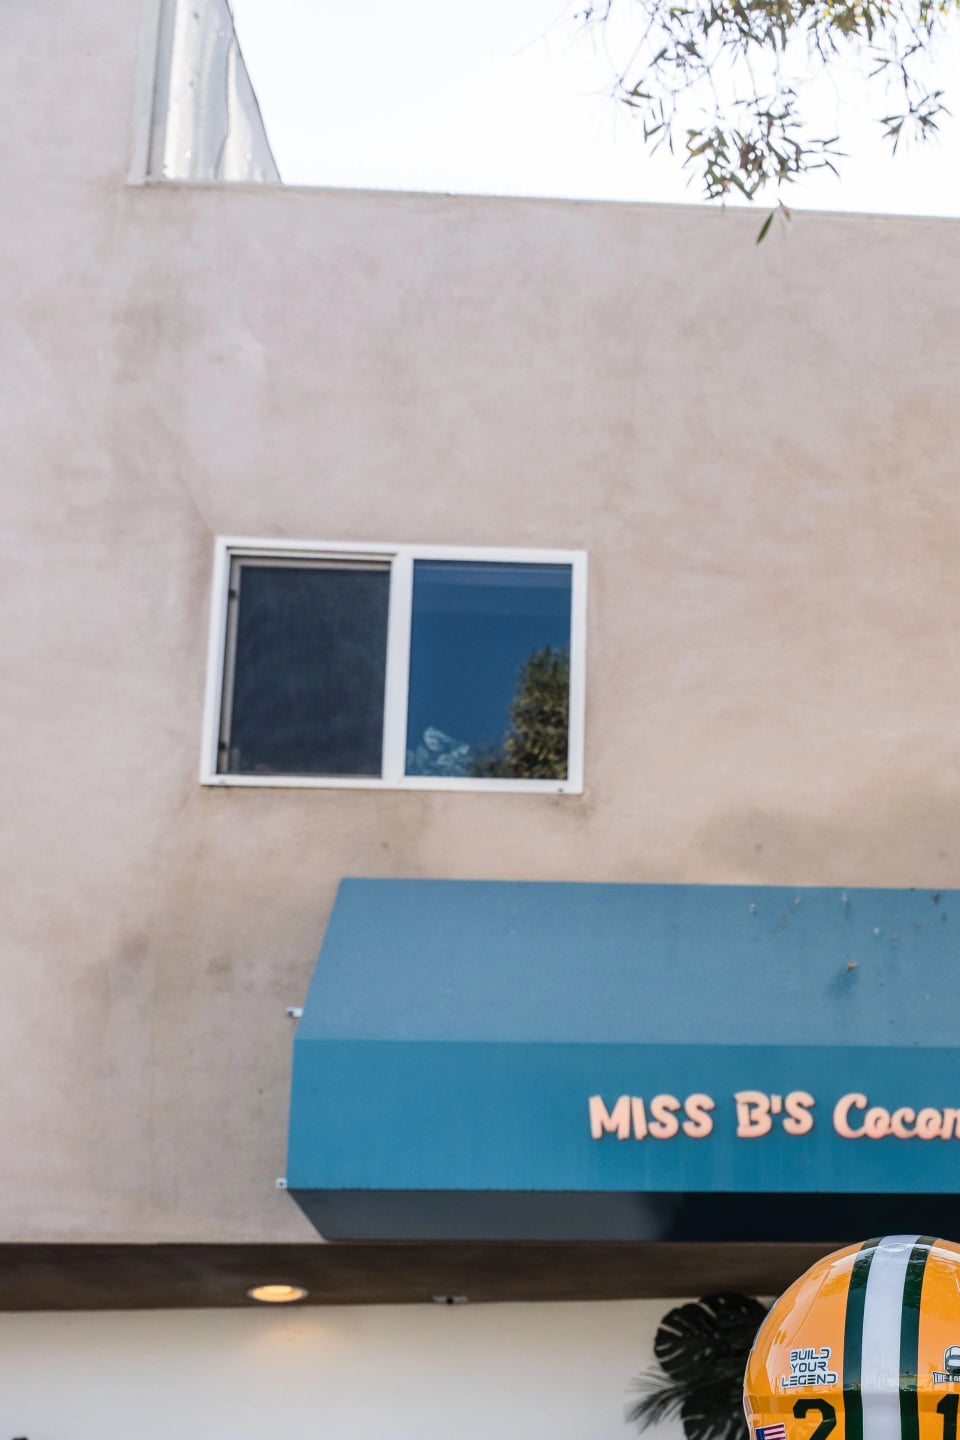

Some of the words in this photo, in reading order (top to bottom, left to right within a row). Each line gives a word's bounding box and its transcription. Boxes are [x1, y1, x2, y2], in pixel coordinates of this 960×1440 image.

[588, 1093, 716, 1141] MISS
[733, 1090, 816, 1138] B'S
[790, 1348, 830, 1362] BUILD
[791, 1361, 827, 1374] YOUR
[781, 1373, 837, 1388] LEGEND
[932, 1371, 947, 1385] THE
